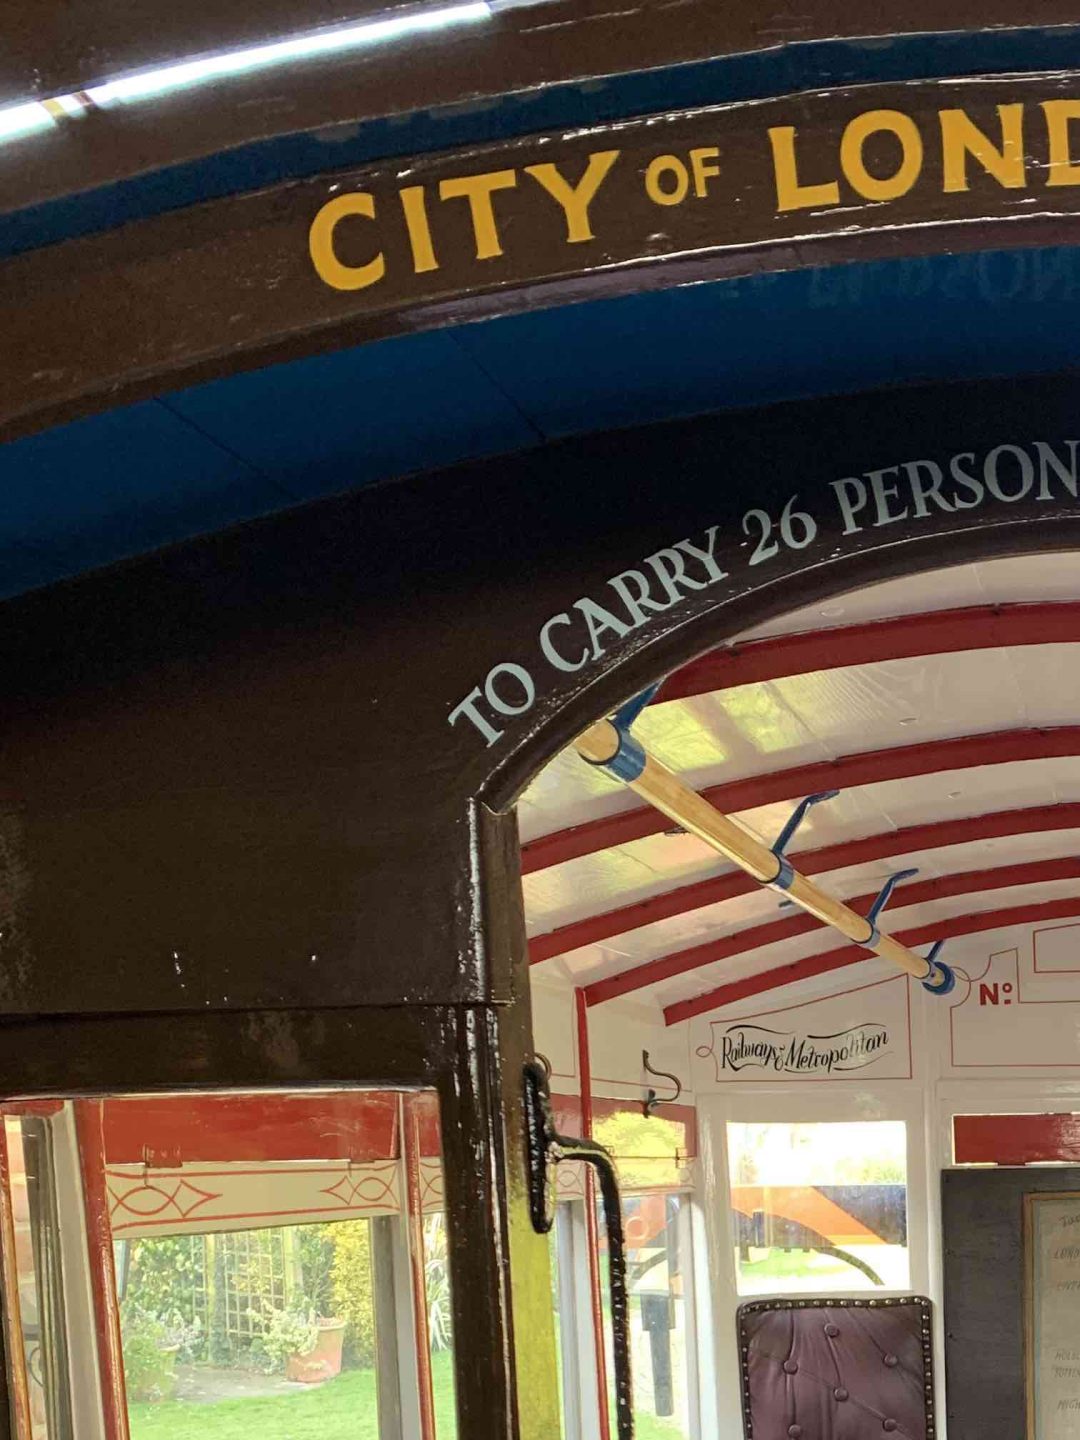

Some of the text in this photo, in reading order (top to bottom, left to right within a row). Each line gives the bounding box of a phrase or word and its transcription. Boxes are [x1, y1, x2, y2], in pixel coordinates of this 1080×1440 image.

[308, 150, 619, 292] CITY
[644, 146, 722, 206] OF
[447, 662, 536, 749] TO
[539, 527, 729, 674] CARRY
[741, 494, 818, 566] 26
[785, 1030, 890, 1073] Metropolitan
